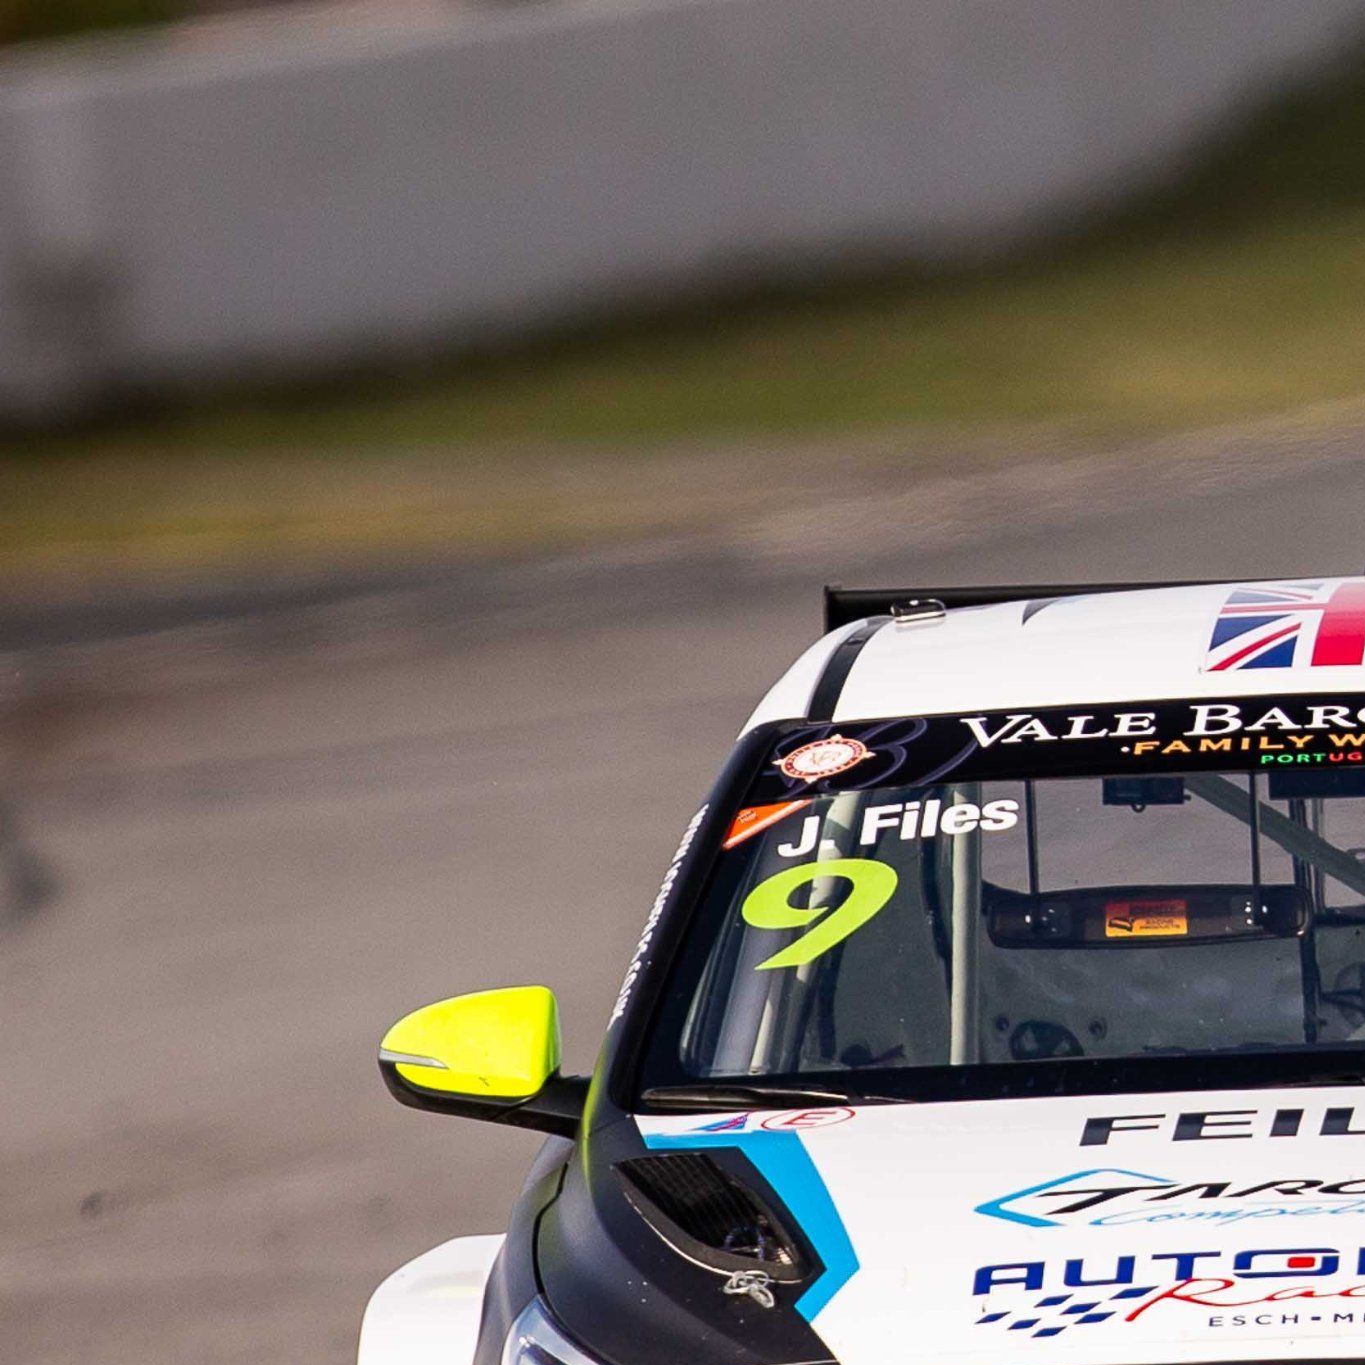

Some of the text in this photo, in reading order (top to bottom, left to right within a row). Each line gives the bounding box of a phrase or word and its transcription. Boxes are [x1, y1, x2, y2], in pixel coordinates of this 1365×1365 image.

[961, 713, 1156, 748] VALE
[1133, 734, 1312, 756] FAMILY
[777, 797, 1020, 858] J. Files
[741, 858, 899, 970] 9
